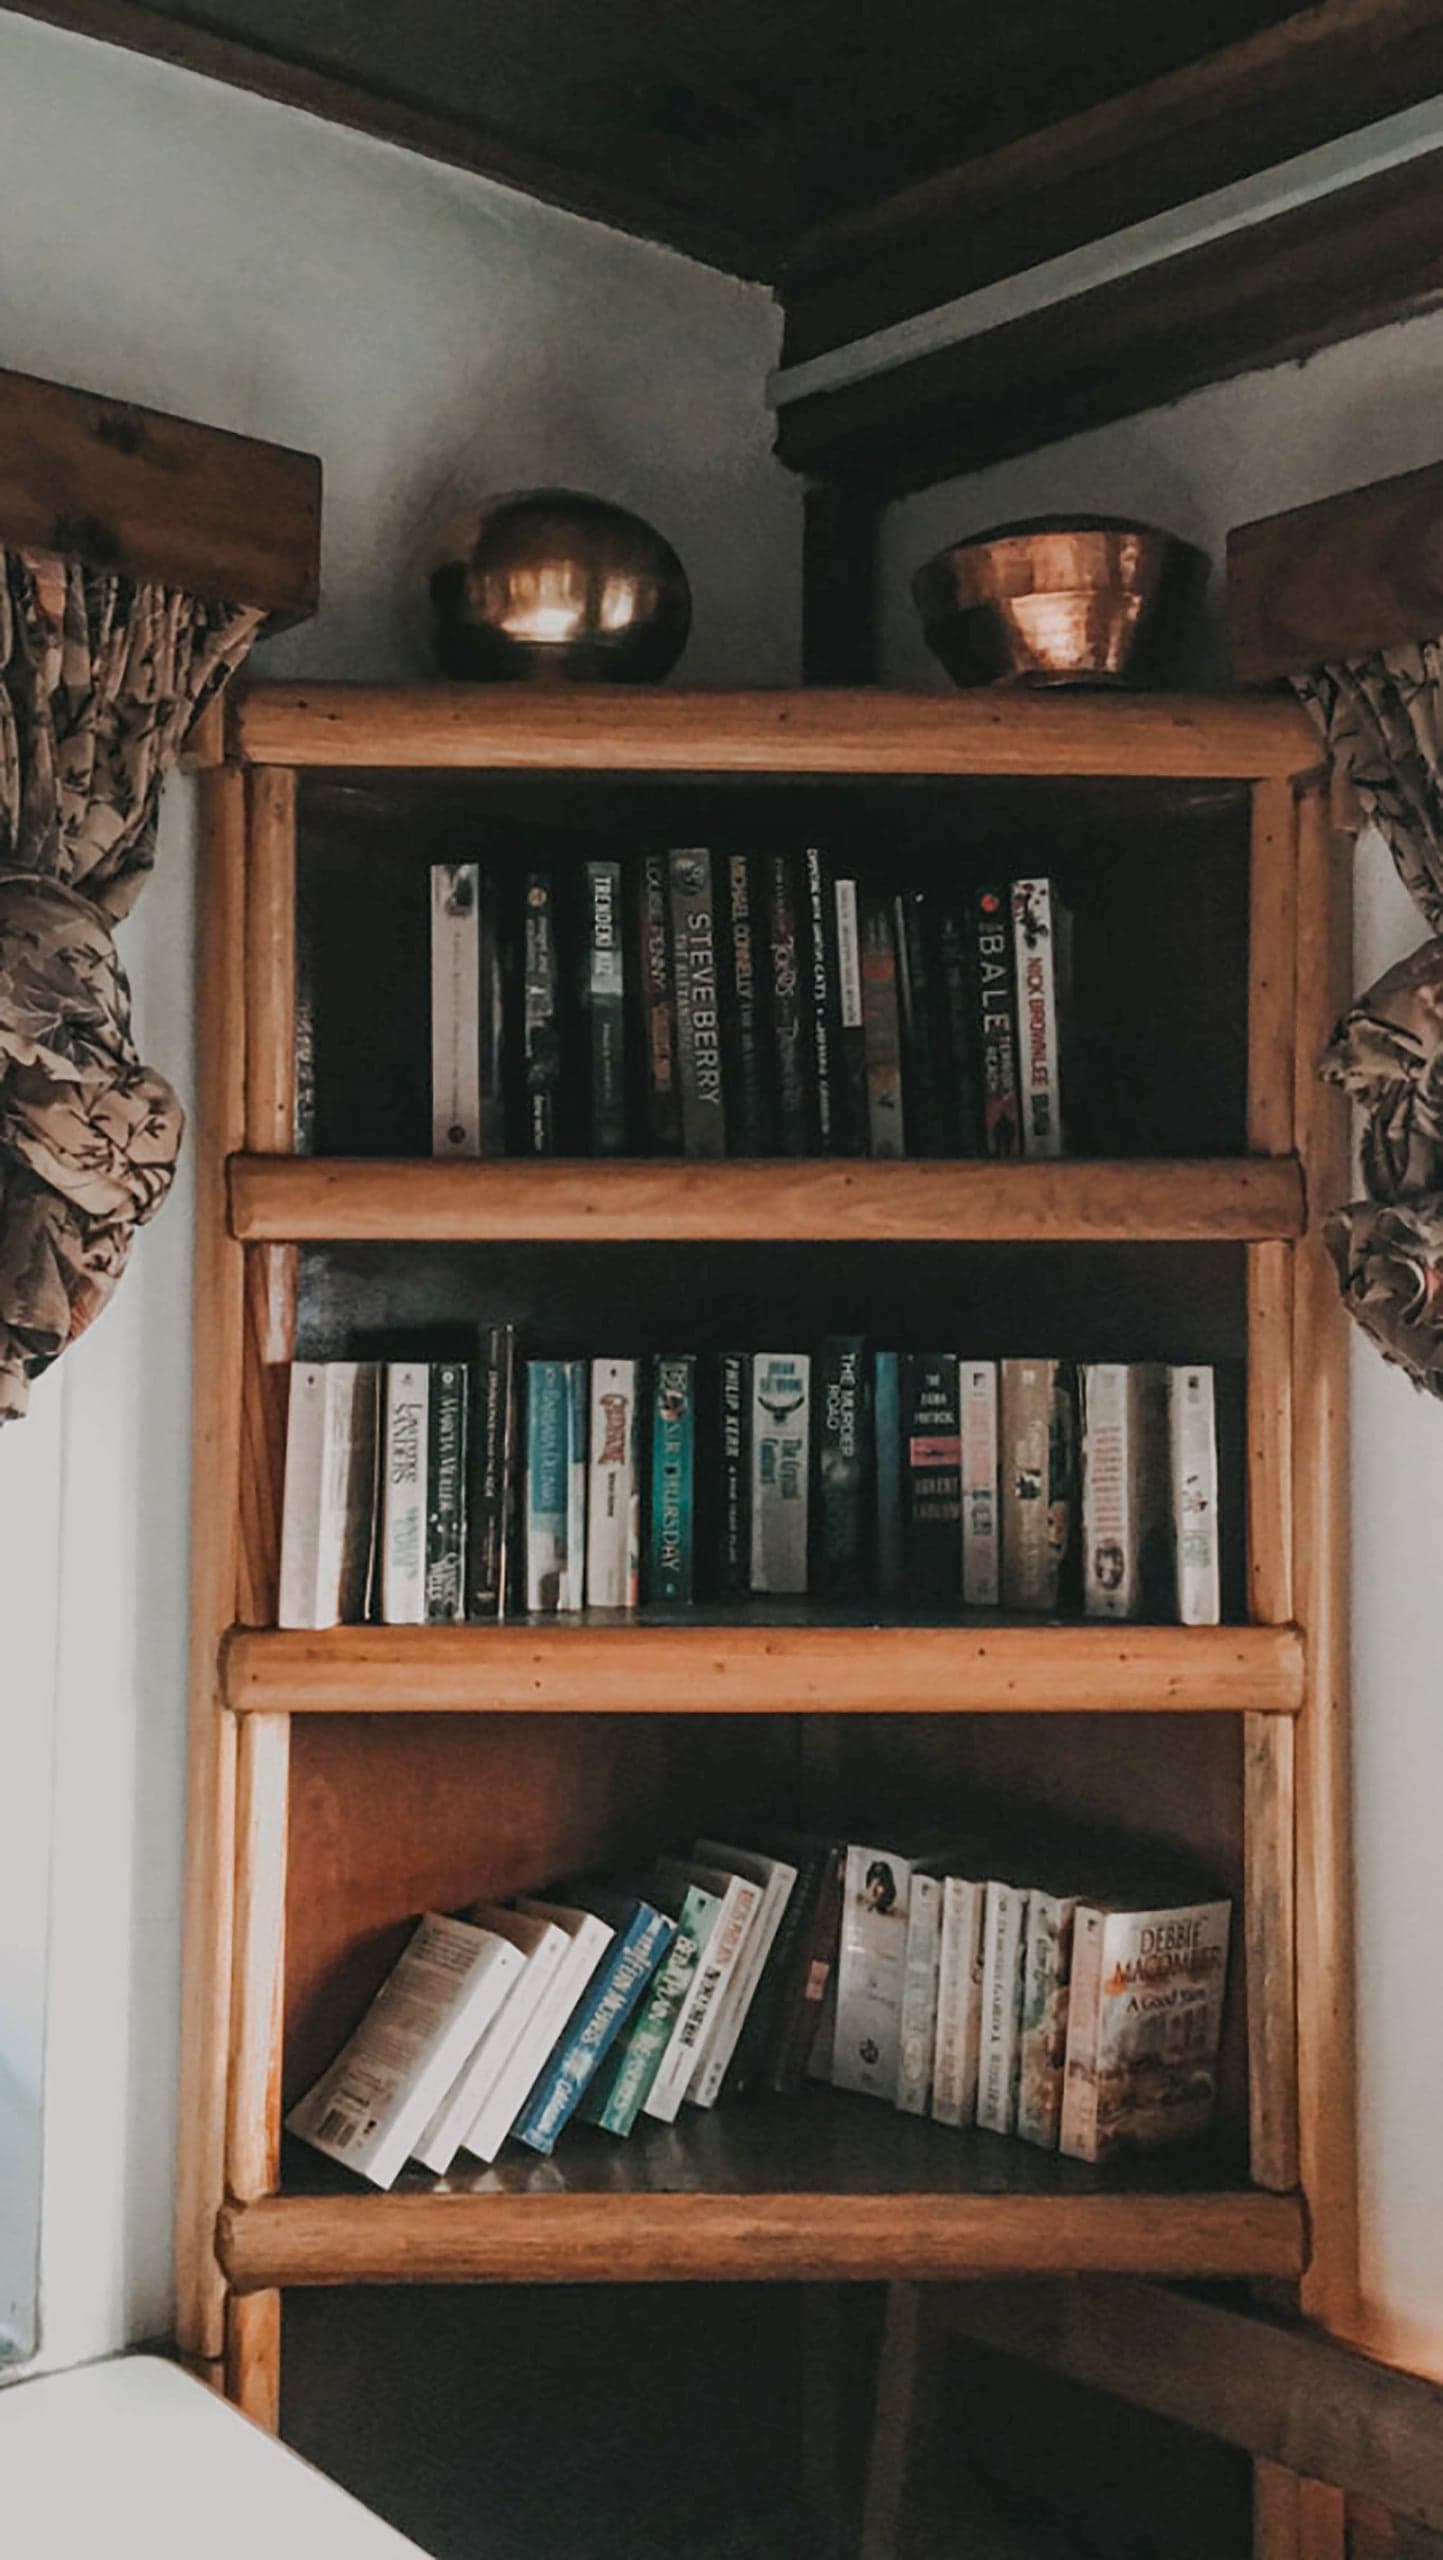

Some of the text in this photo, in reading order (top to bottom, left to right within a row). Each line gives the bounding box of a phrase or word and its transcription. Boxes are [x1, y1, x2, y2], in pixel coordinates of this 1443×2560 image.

[730, 856, 750, 921] MICHAEL
[649, 924, 667, 990] PENNY
[735, 923, 754, 999] CONNELLY
[978, 934, 1010, 1033] BALE
[1026, 956, 1045, 995] NICK
[687, 912, 720, 1104] STEVE BERRY
[1028, 1000, 1050, 1087] BROWNLEE
[391, 1403, 407, 1484] SANDERS
[440, 1397, 459, 1454] MARCIA
[724, 1356, 741, 1457] PHILIP KERR
[826, 1384, 841, 1431] ROAD
[839, 1353, 857, 1457] THE MURDER
[661, 1422, 681, 1573] SIR THURSDAY
[1140, 1919, 1202, 1955] DEBBIE
